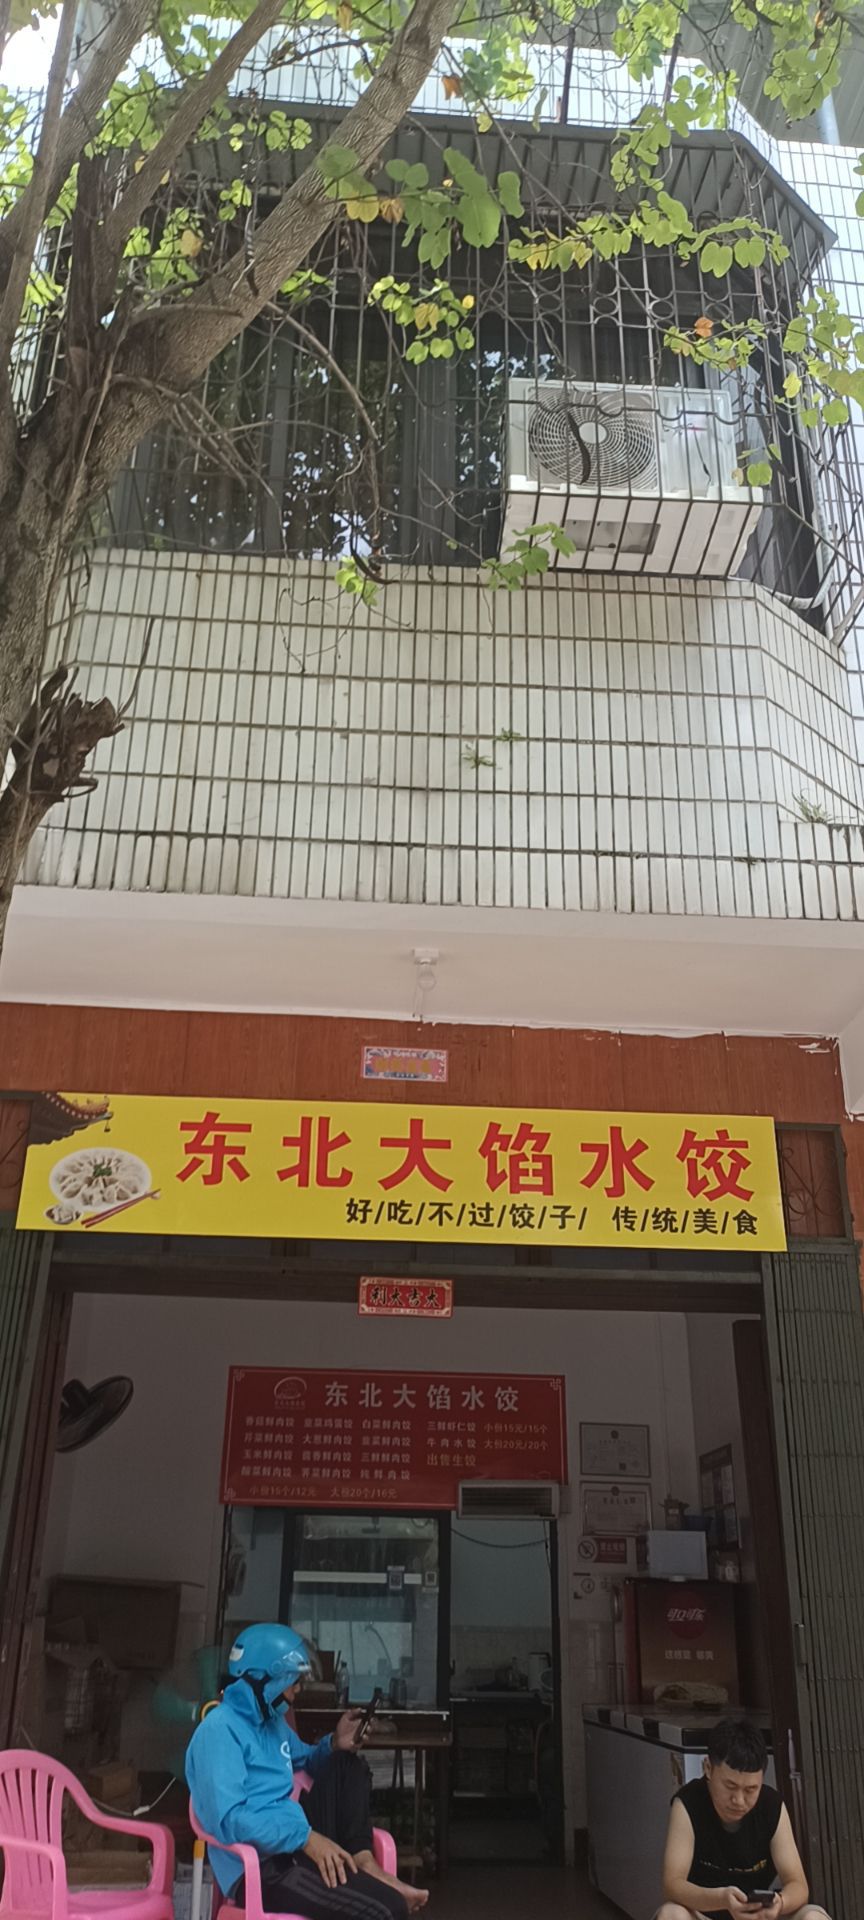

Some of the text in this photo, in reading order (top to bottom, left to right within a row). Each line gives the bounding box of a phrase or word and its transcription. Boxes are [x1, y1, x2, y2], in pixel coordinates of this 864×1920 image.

[176, 1111, 756, 1203] 东北大馅水饺
[345, 1197, 759, 1236] 好/吃/不/过/饺/子/ 传/统/美/食
[325, 1381, 520, 1412] 东北大馅水饺
[362, 1419, 411, 1431] 白菜鲜肉饺
[426, 1421, 477, 1432] 三鲜虾仁饺
[426, 1437, 477, 1449] 牛肉水饺
[360, 1452, 411, 1464] 三鲜鲜肉饺
[426, 1453, 477, 1467] 出售生饺
